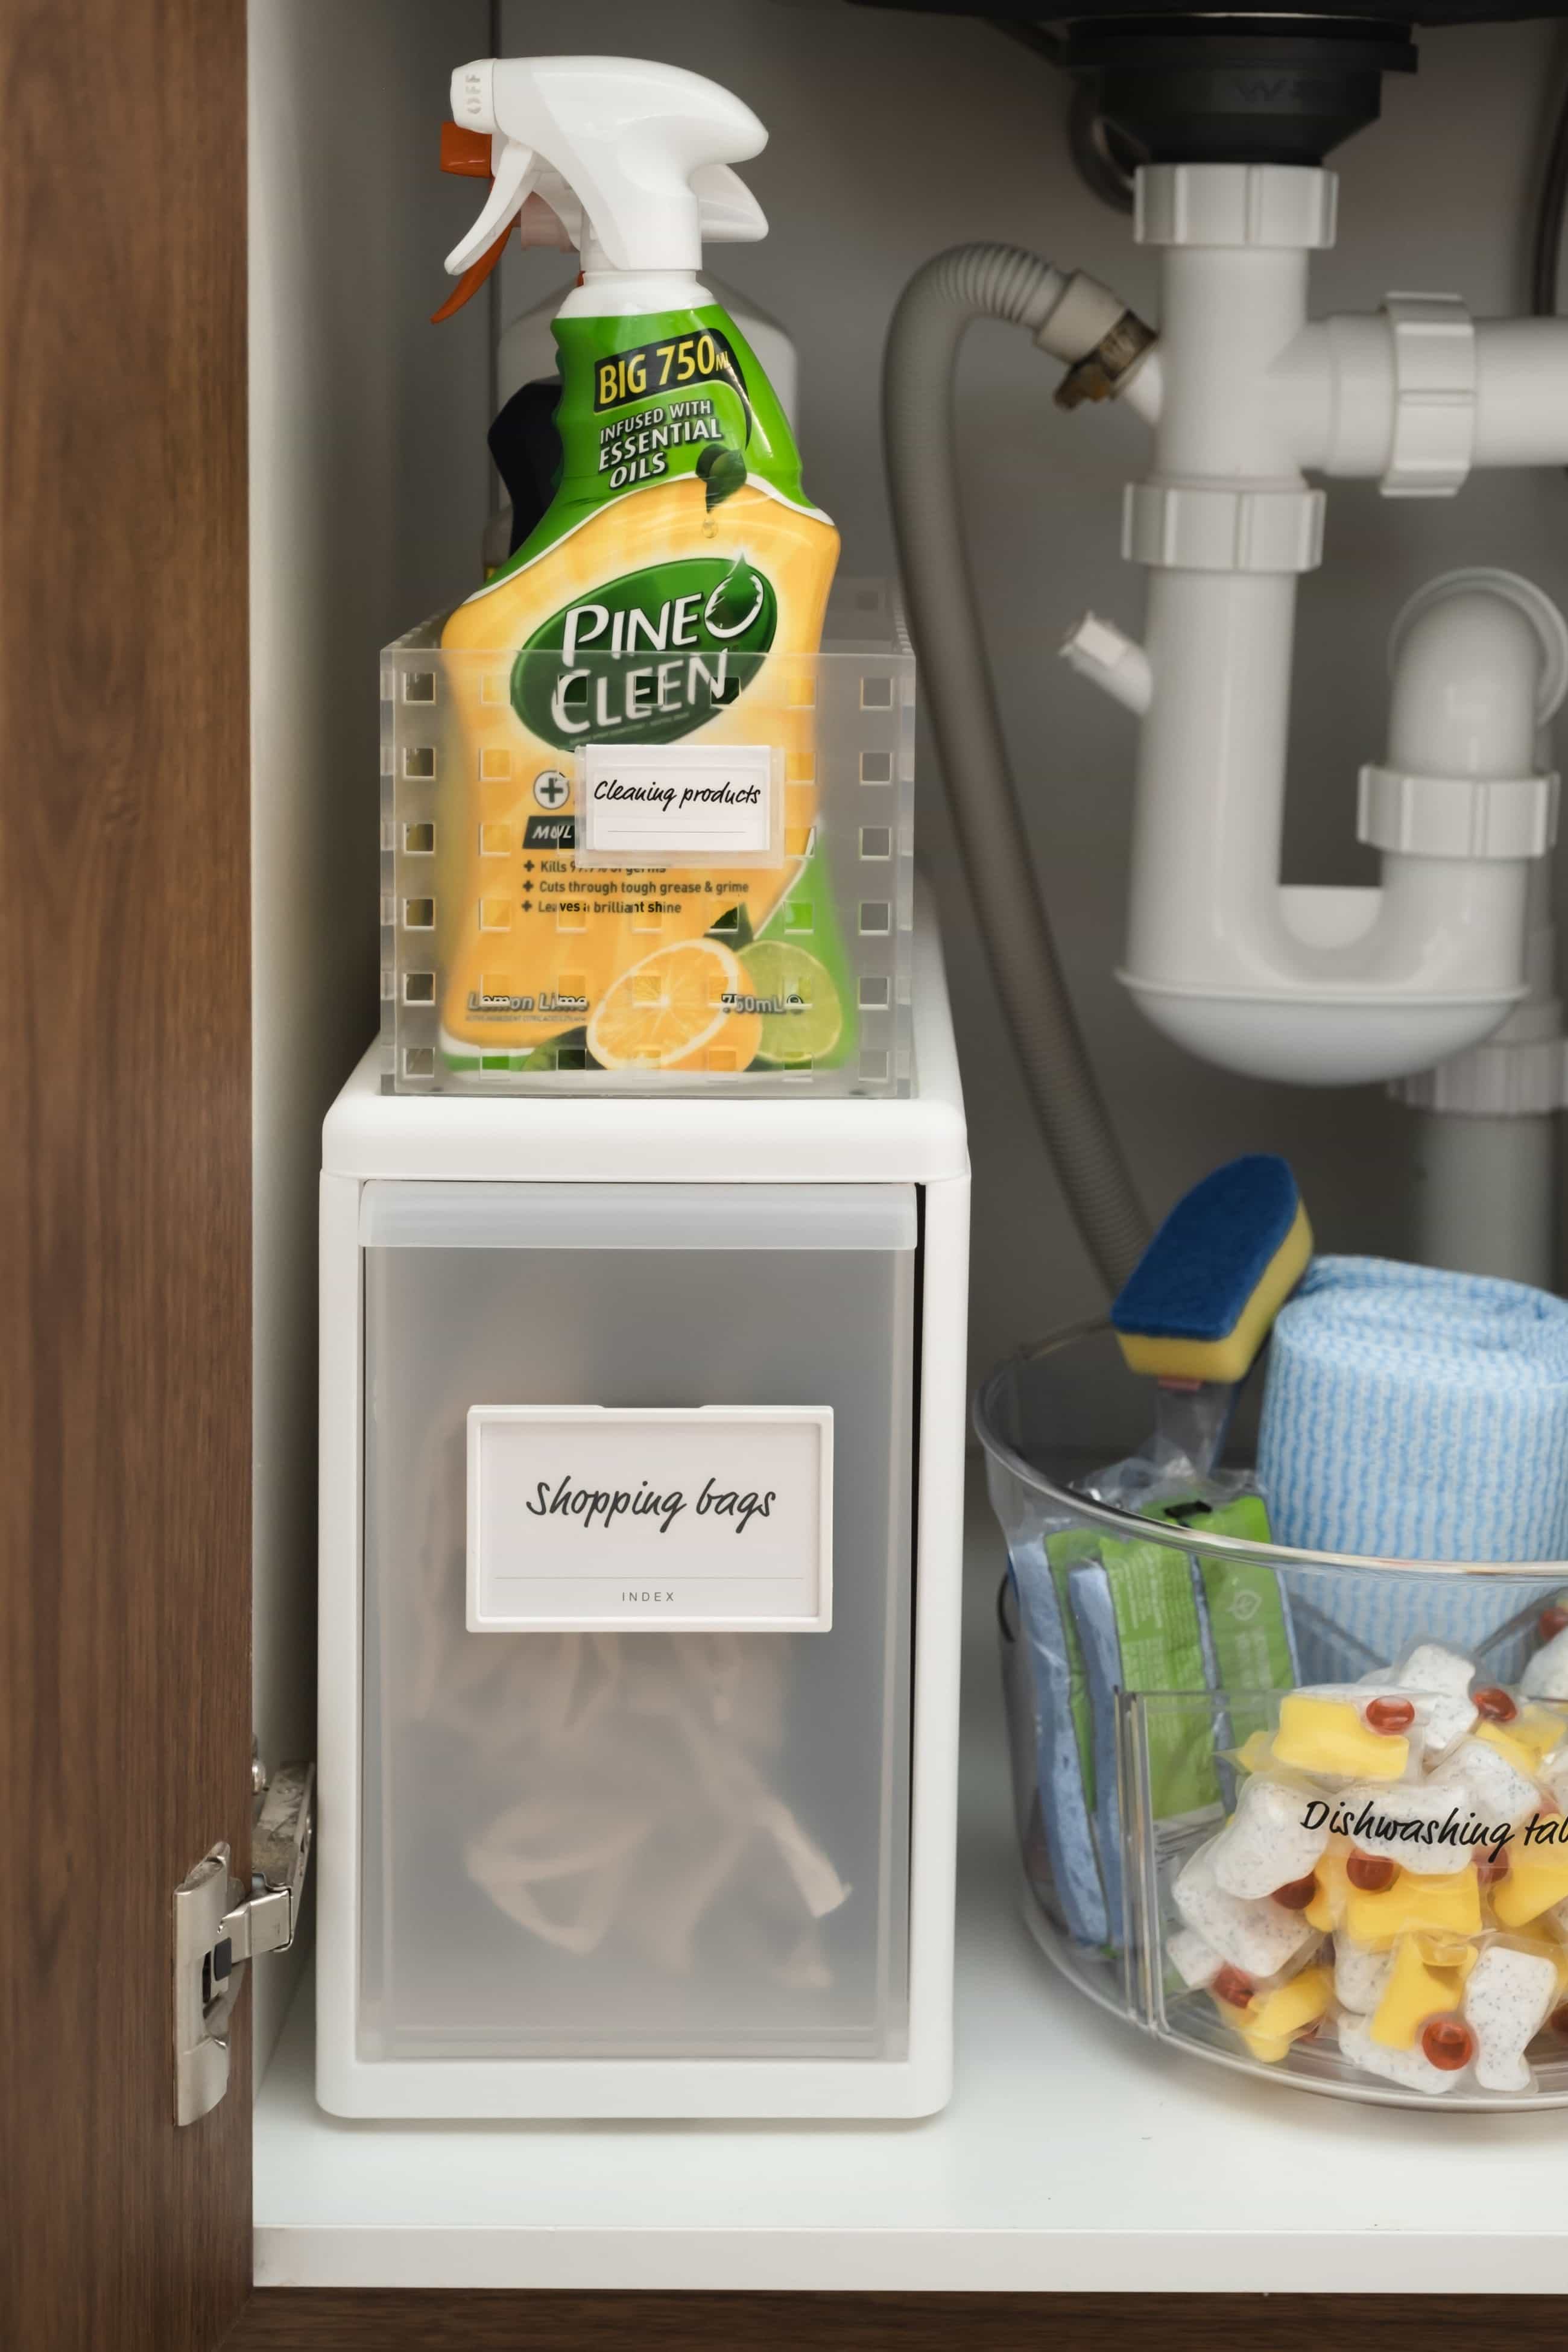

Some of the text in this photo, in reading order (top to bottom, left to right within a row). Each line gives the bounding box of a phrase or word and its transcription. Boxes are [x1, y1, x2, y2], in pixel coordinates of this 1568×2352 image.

[465, 74, 482, 115] OFF
[599, 353, 647, 405] BIG
[599, 400, 711, 444] INFUSED WITH
[598, 418, 722, 472] ESSENTIAL
[609, 452, 666, 489] OILS
[551, 647, 729, 735] CLEEN
[593, 779, 761, 812] Cleaning products
[540, 860, 567, 873] Kills
[540, 880, 749, 896] Cuts through tough grease & grime
[593, 900, 645, 913] brilliant
[648, 900, 682, 913] shine
[526, 1475, 776, 1534] Shopping bags
[622, 1592, 675, 1602] INDEX
[1300, 1800, 1516, 1864] Dishwashing
